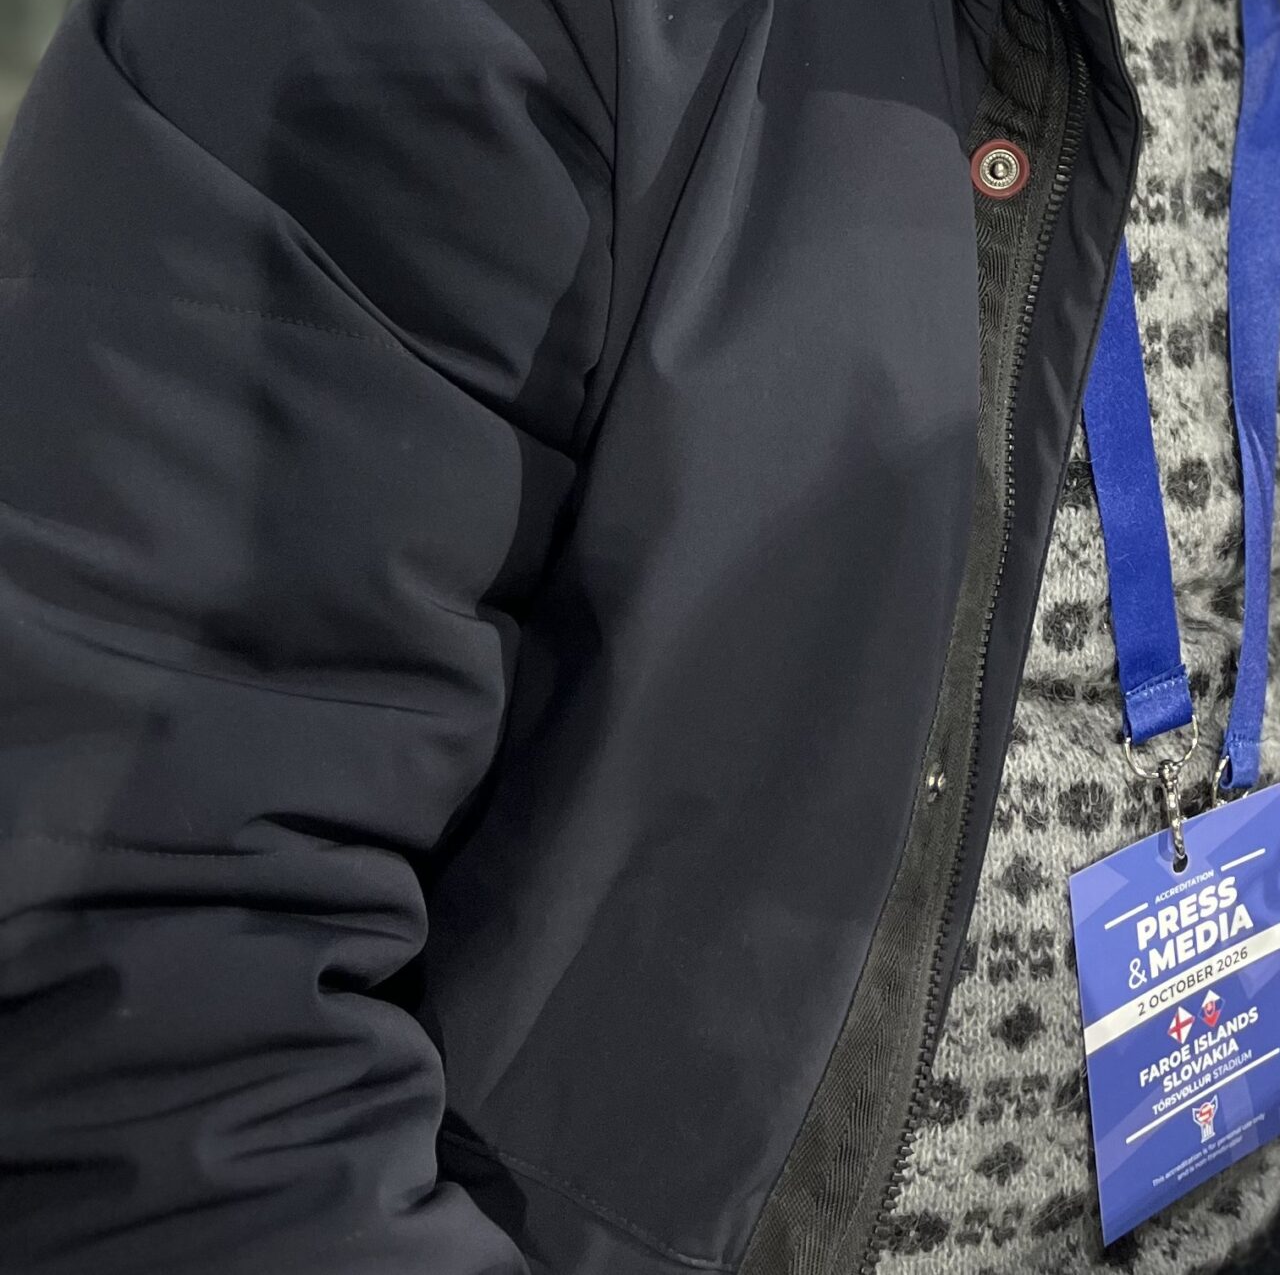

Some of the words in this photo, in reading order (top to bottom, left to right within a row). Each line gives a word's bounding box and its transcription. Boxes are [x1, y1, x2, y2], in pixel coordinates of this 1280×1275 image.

[1137, 876, 1238, 951] PRESS
[1155, 869, 1215, 904] ACCREDITATION
[1138, 1002, 1146, 1016] 2
[1149, 965, 1213, 1008] OCTOBER
[1217, 946, 1248, 973] 2026
[1140, 1044, 1191, 1087] FAROE
[1193, 1006, 1258, 1055] ISLANDS
[1163, 1038, 1239, 1092] SLOVAKIA
[1213, 1049, 1252, 1080] STADIUM
